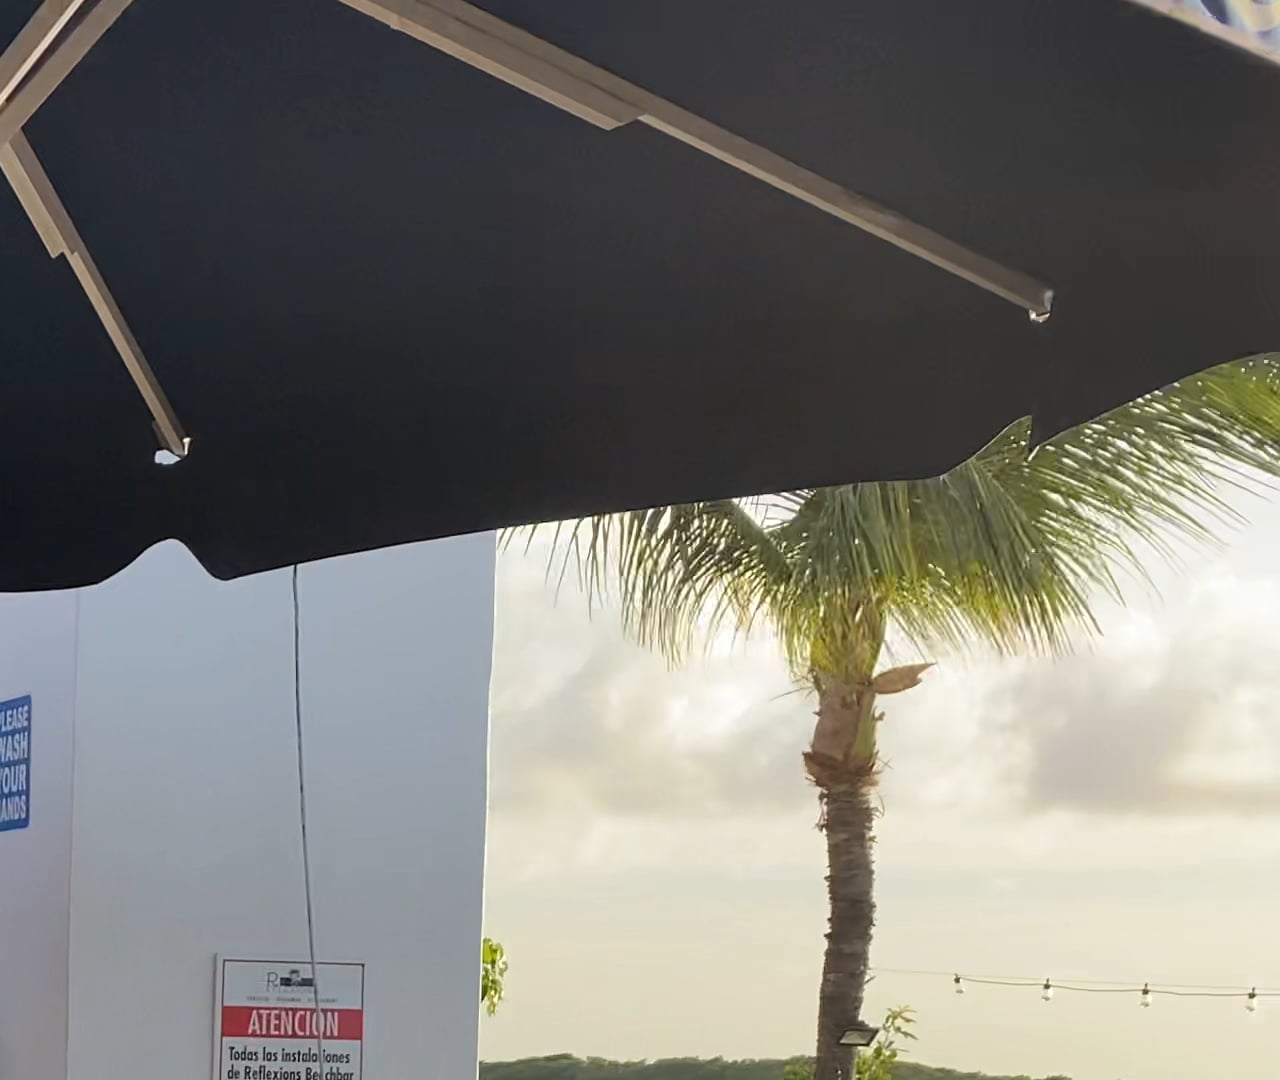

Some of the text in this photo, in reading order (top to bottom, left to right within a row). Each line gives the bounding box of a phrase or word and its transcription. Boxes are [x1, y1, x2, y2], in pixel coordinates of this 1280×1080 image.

[228, 1046, 351, 1063] Todas las instalaiones
[227, 1064, 240, 1080] de
[243, 1065, 301, 1080] Reflexions
